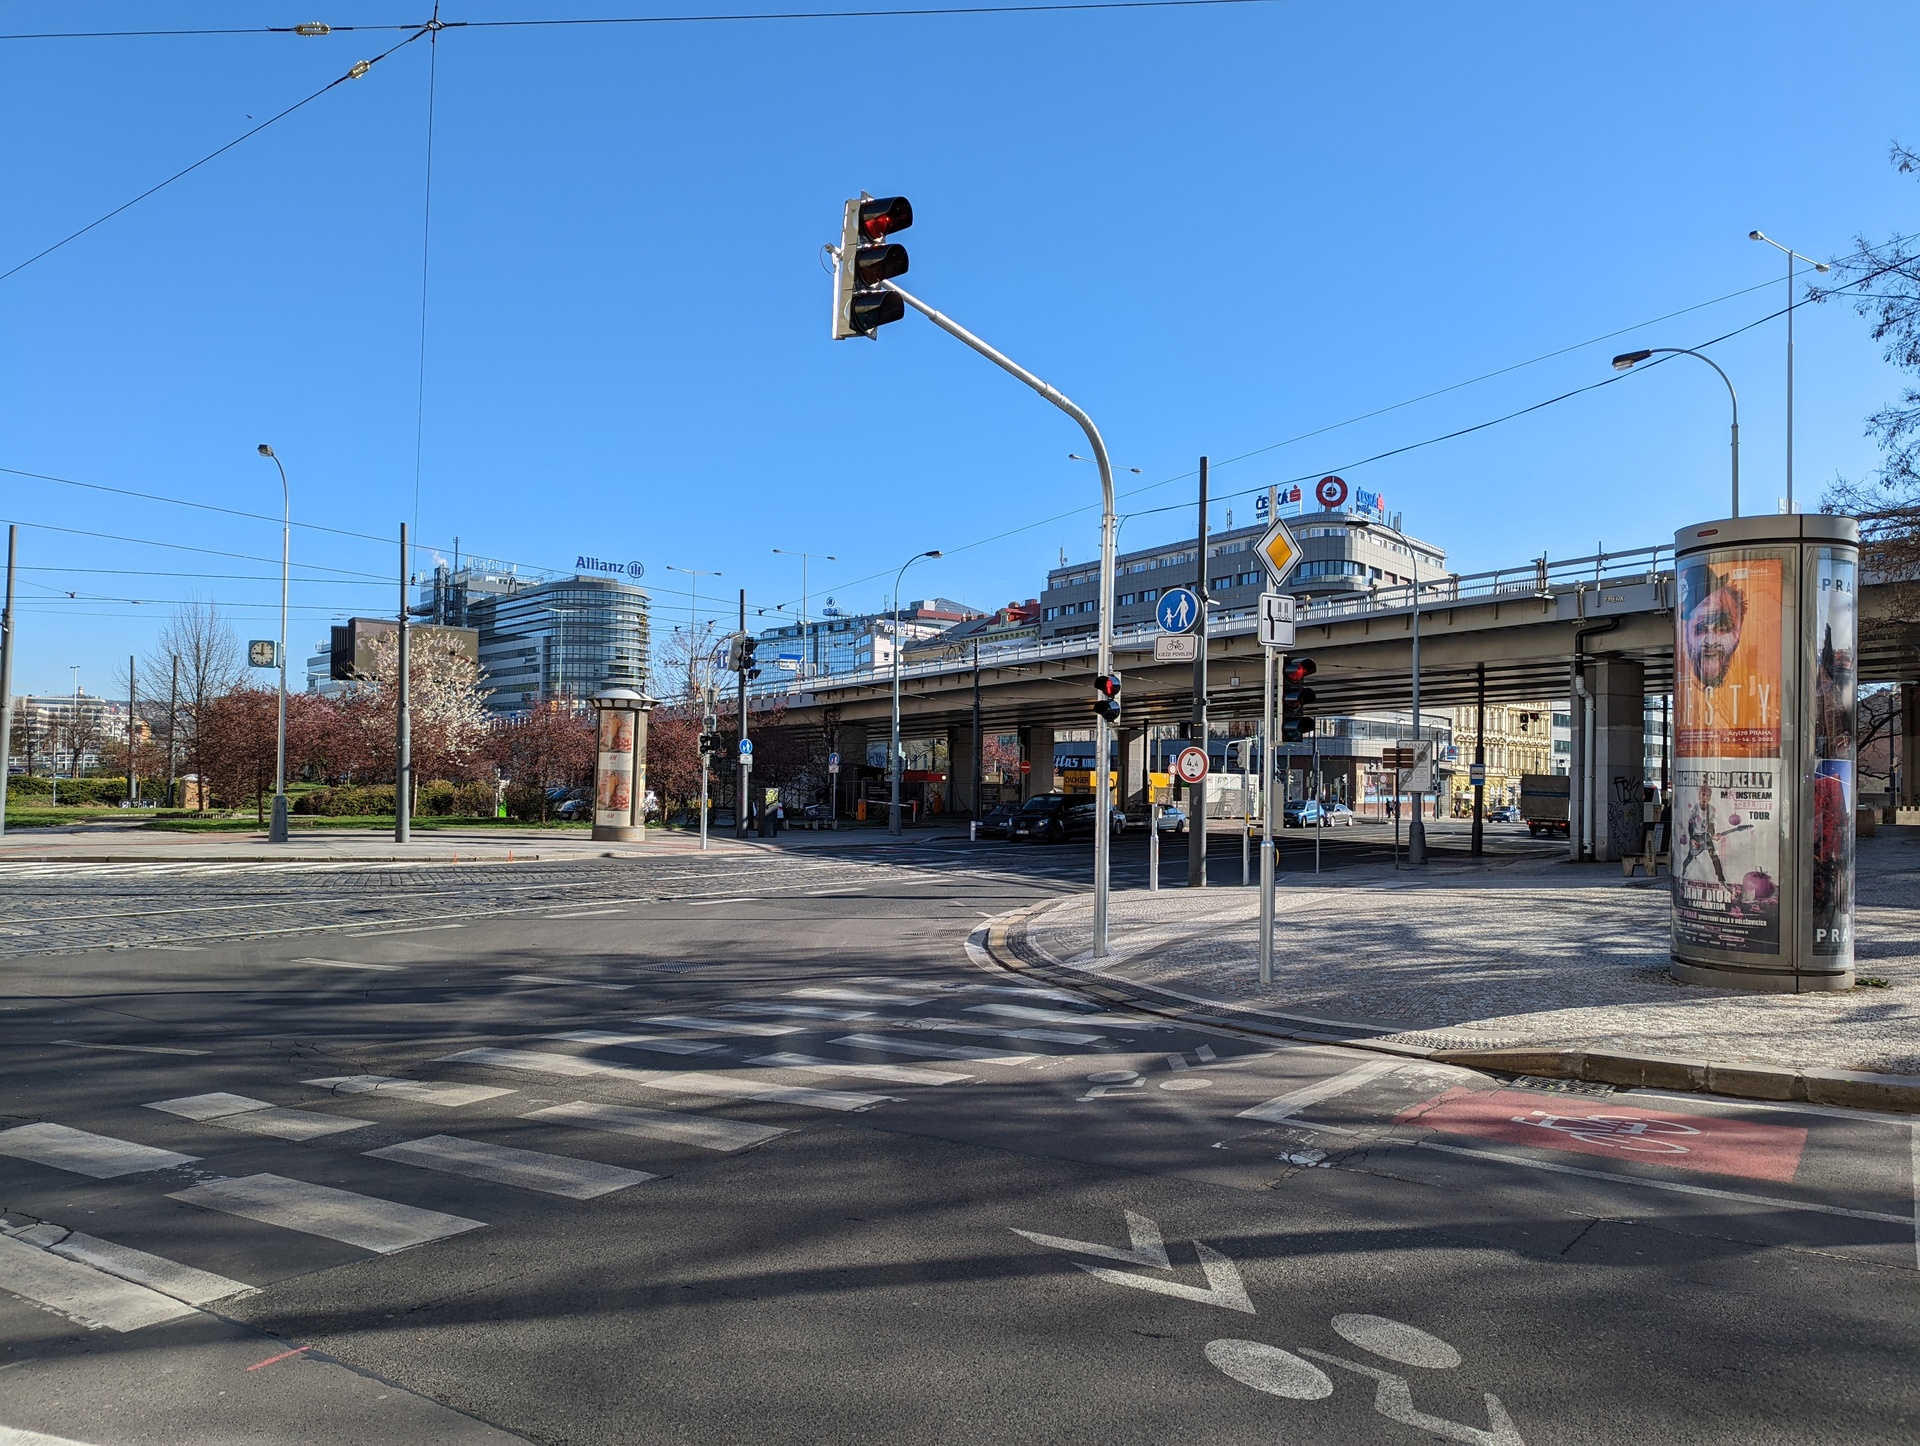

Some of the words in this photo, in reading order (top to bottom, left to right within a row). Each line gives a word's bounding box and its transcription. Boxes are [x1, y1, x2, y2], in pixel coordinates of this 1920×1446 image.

[575, 555, 625, 573] Allianz
[1065, 776, 1090, 784] DACHSER
[1707, 772, 1731, 788] GUN
[1732, 771, 1771, 788] KELLY
[1749, 811, 1769, 820] TOUR
